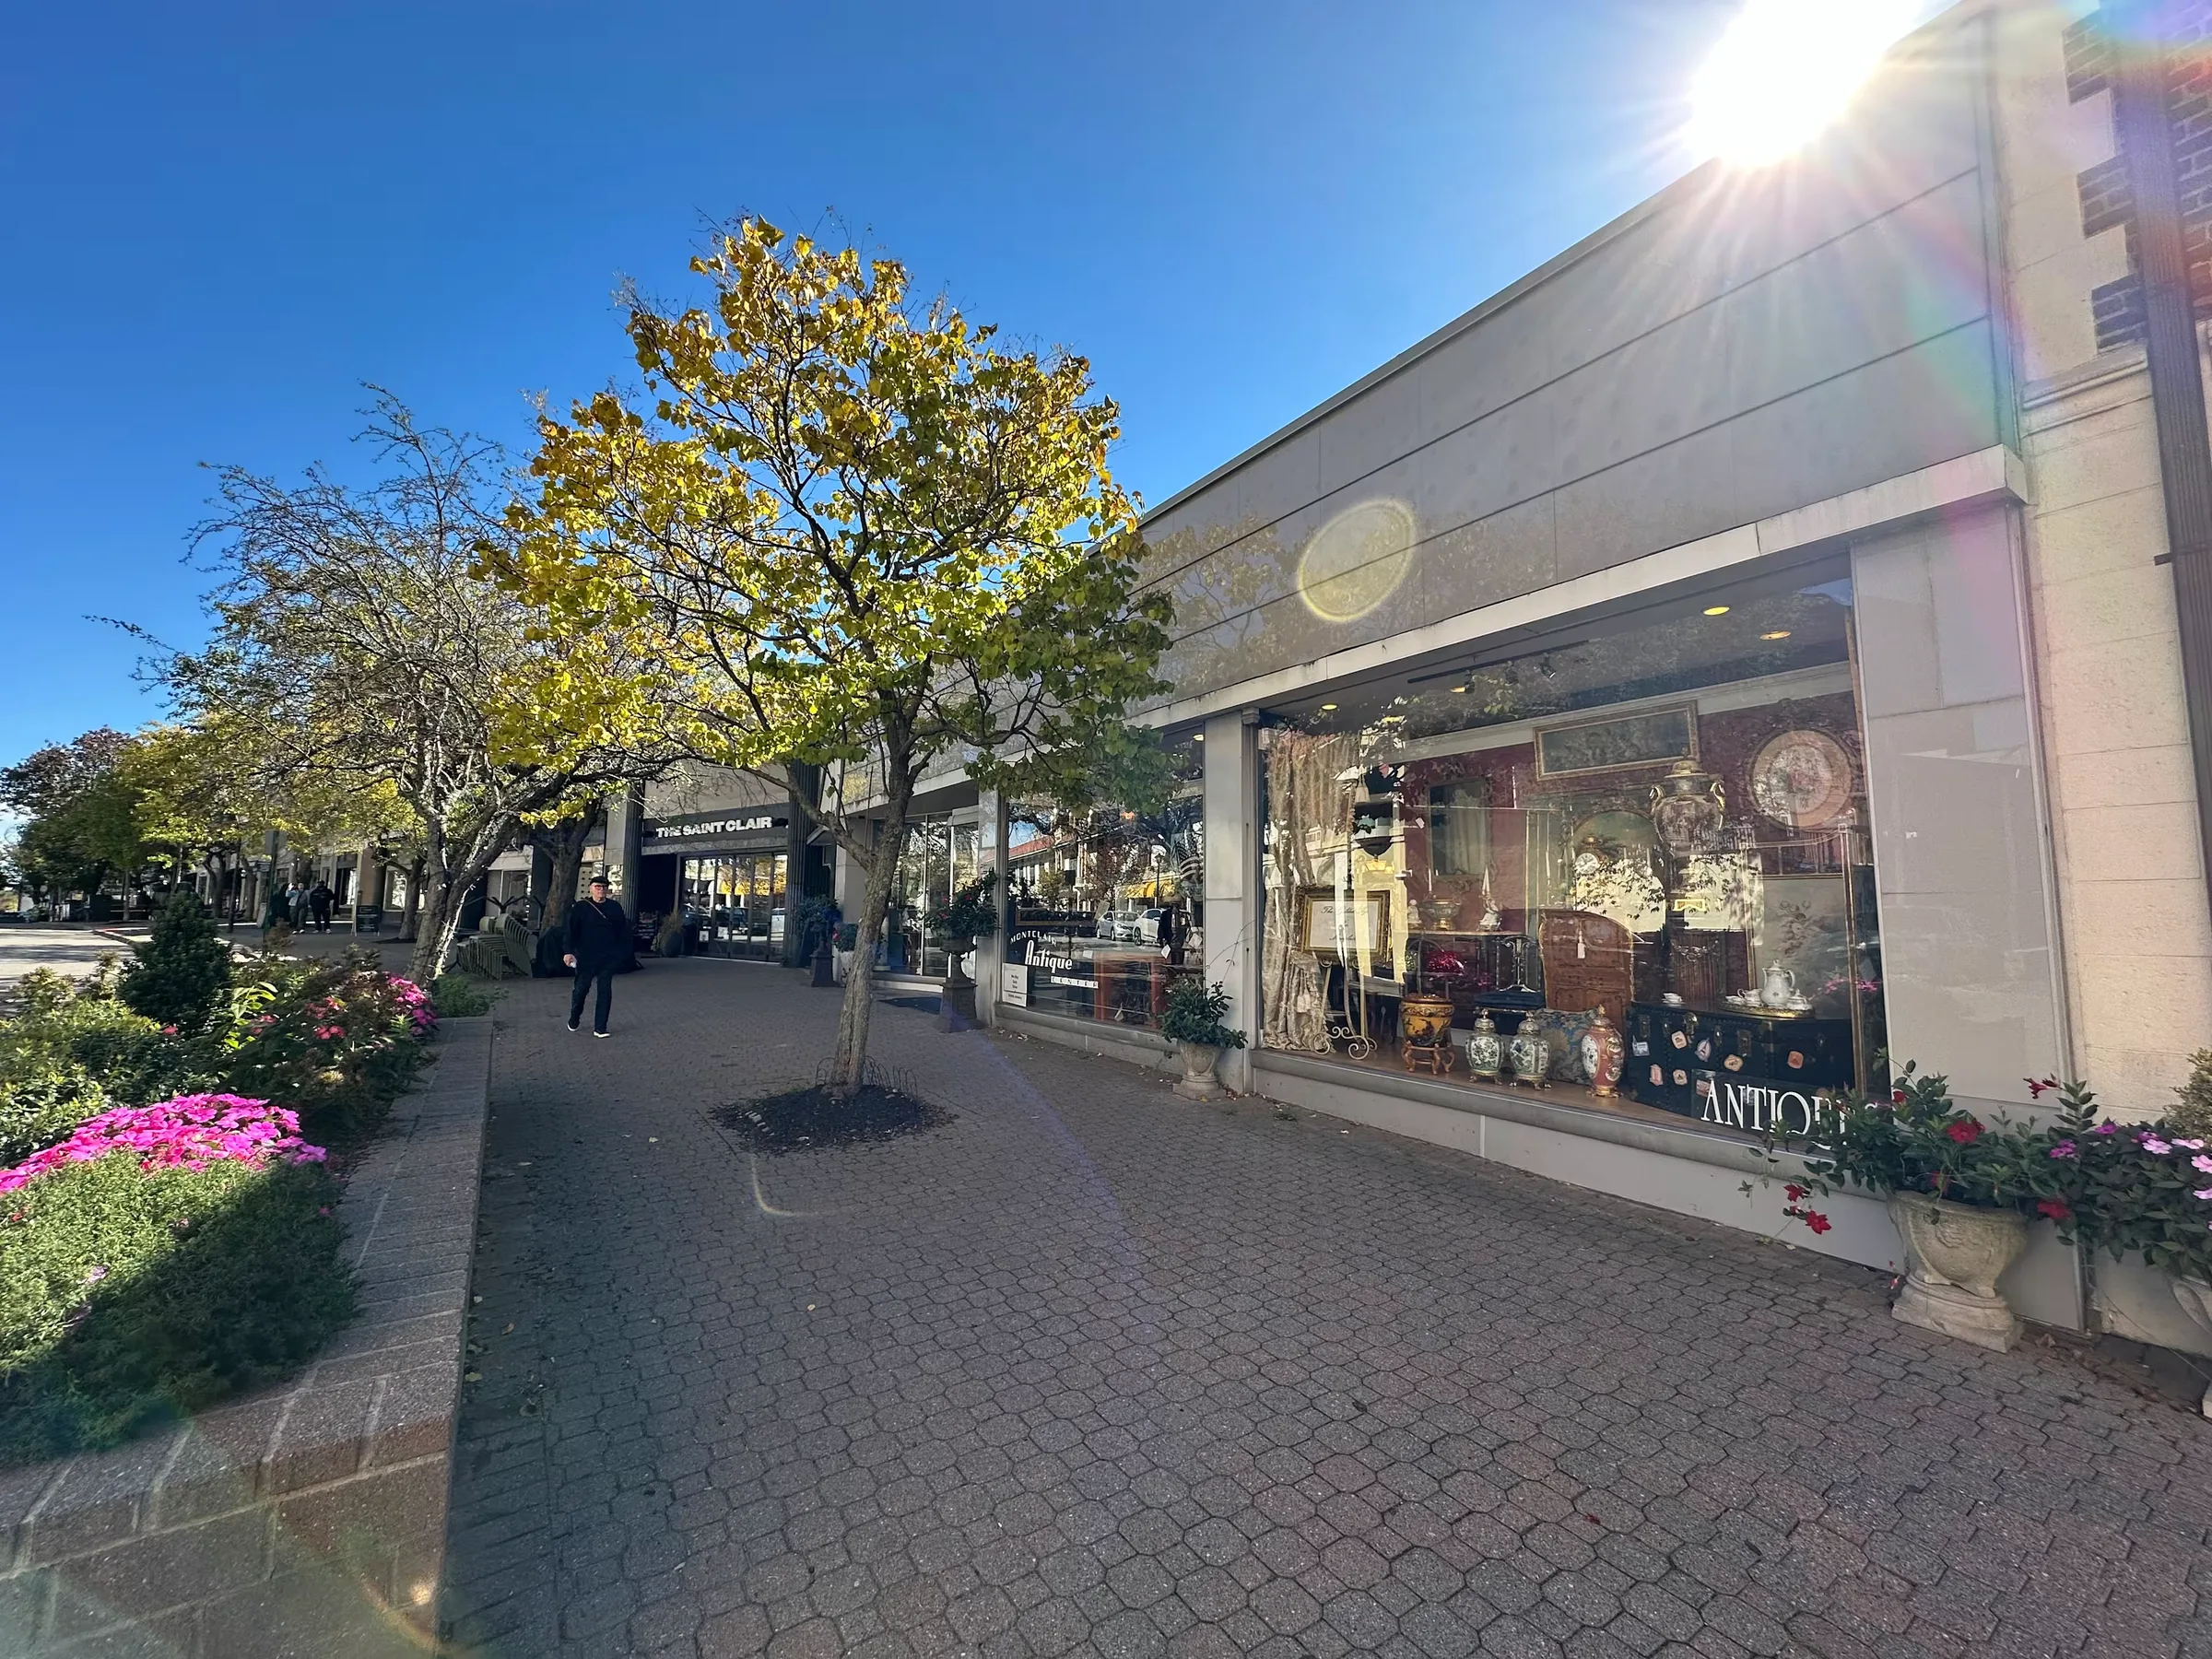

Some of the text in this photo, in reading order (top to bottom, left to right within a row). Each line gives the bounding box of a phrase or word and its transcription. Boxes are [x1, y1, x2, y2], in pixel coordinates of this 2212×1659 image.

[656, 817, 772, 838] THE SAINT CLAIR
[1010, 930, 1057, 947] MONTCLAIR
[1025, 940, 1073, 973] Antique
[1052, 977, 1098, 988] CENTER
[1700, 1077, 1878, 1151] ANTIQU
